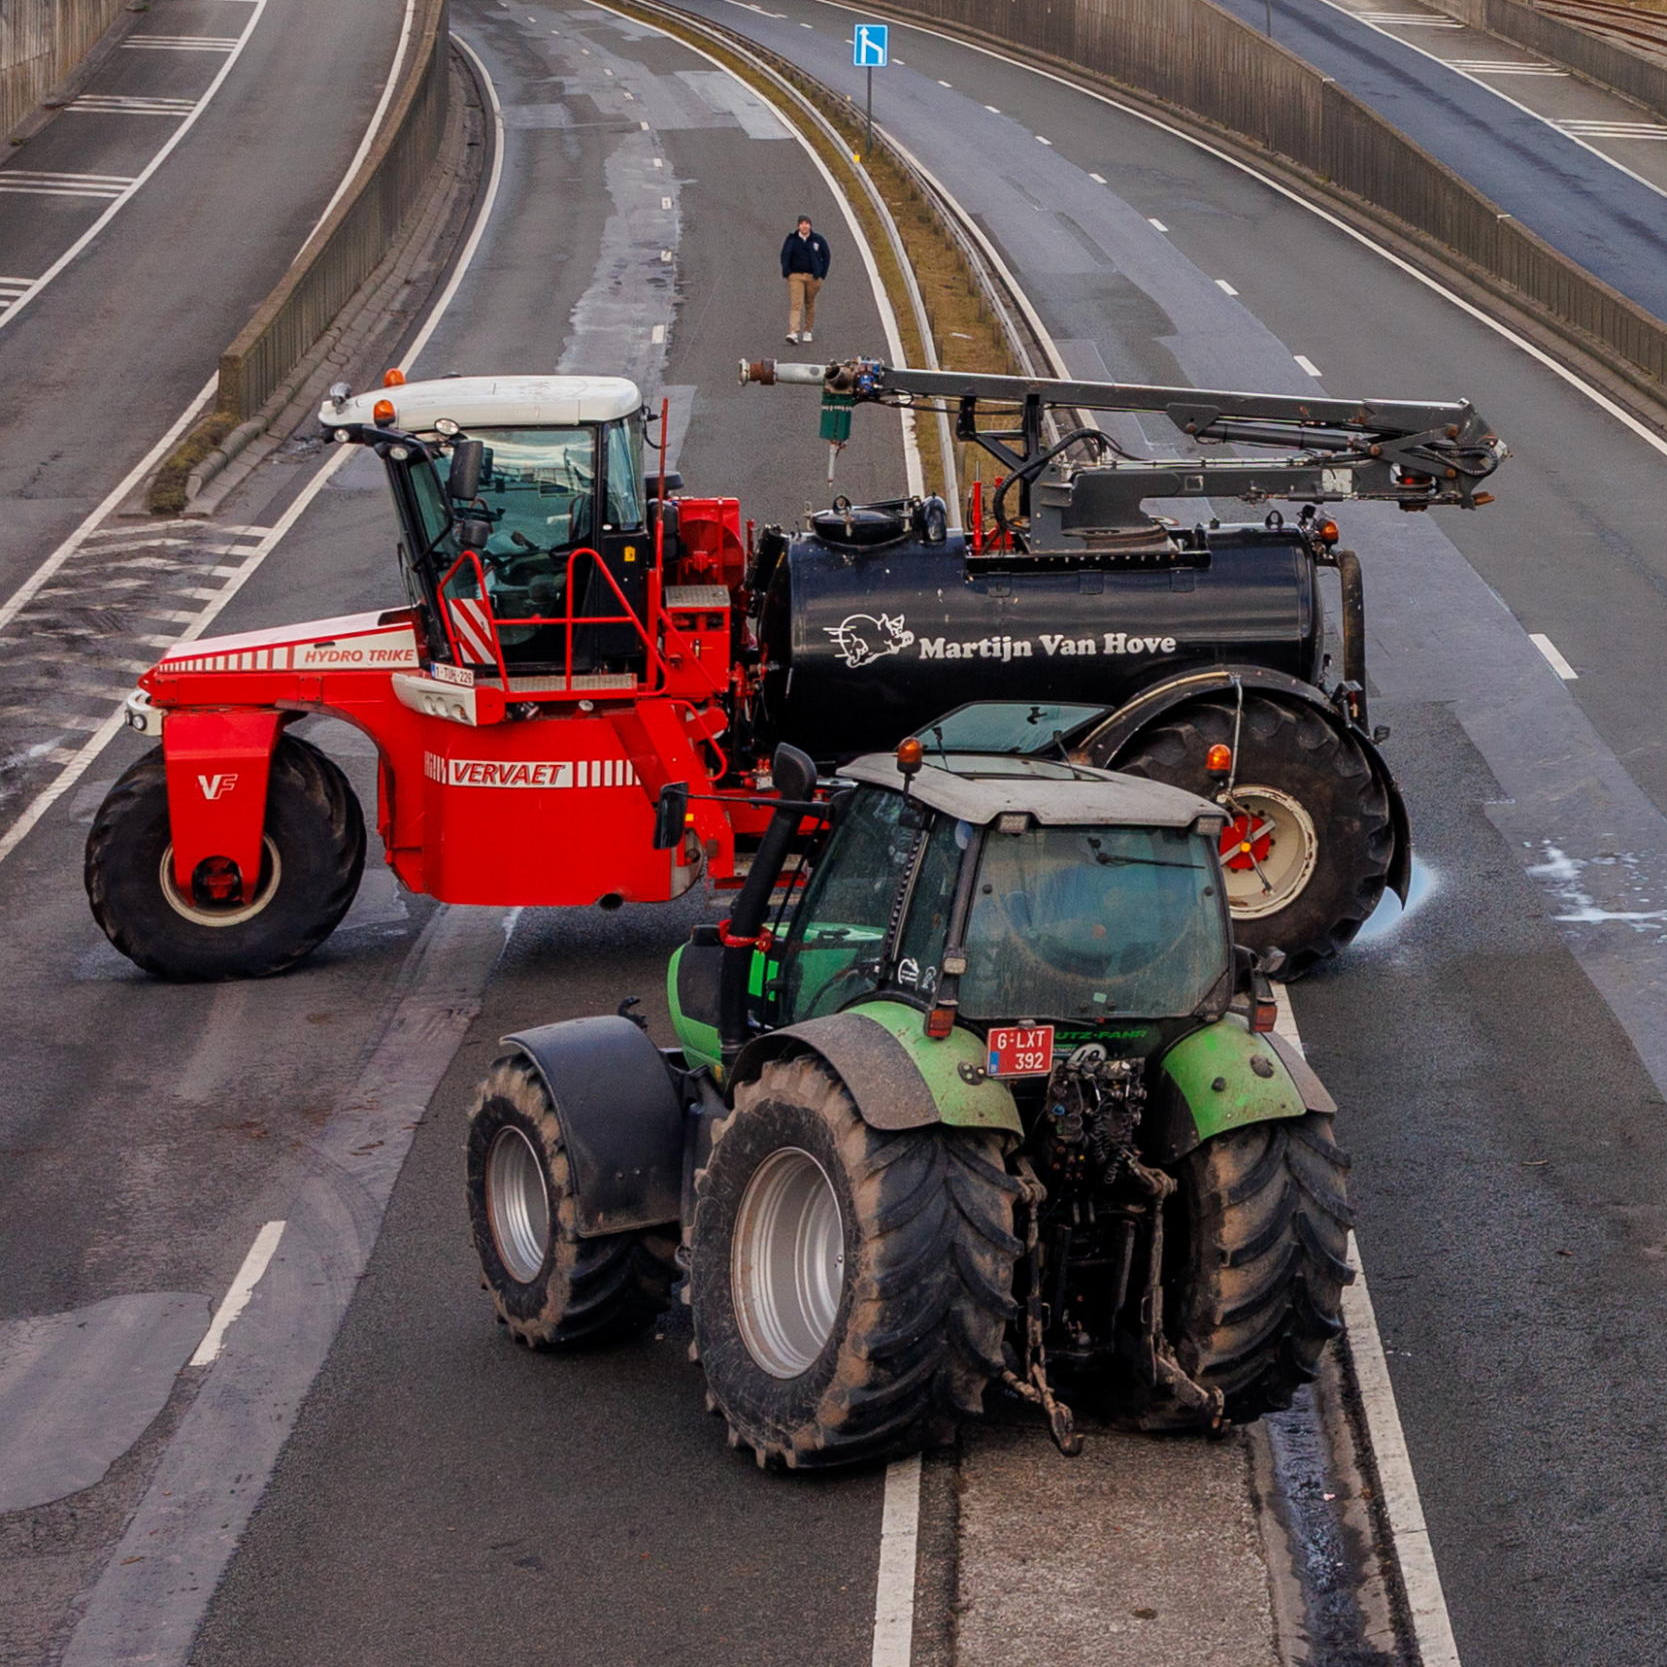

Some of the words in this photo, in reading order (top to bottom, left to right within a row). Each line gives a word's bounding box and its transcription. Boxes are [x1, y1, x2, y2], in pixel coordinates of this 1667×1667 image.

[304, 650, 363, 663] HYDRO
[369, 649, 414, 662] TRIKE
[919, 637, 1033, 662] Martijn
[1039, 635, 1096, 656] Van
[1103, 633, 1176, 654] Hove
[453, 763, 566, 785] VERVAET
[1015, 1053, 1043, 1070] 392
